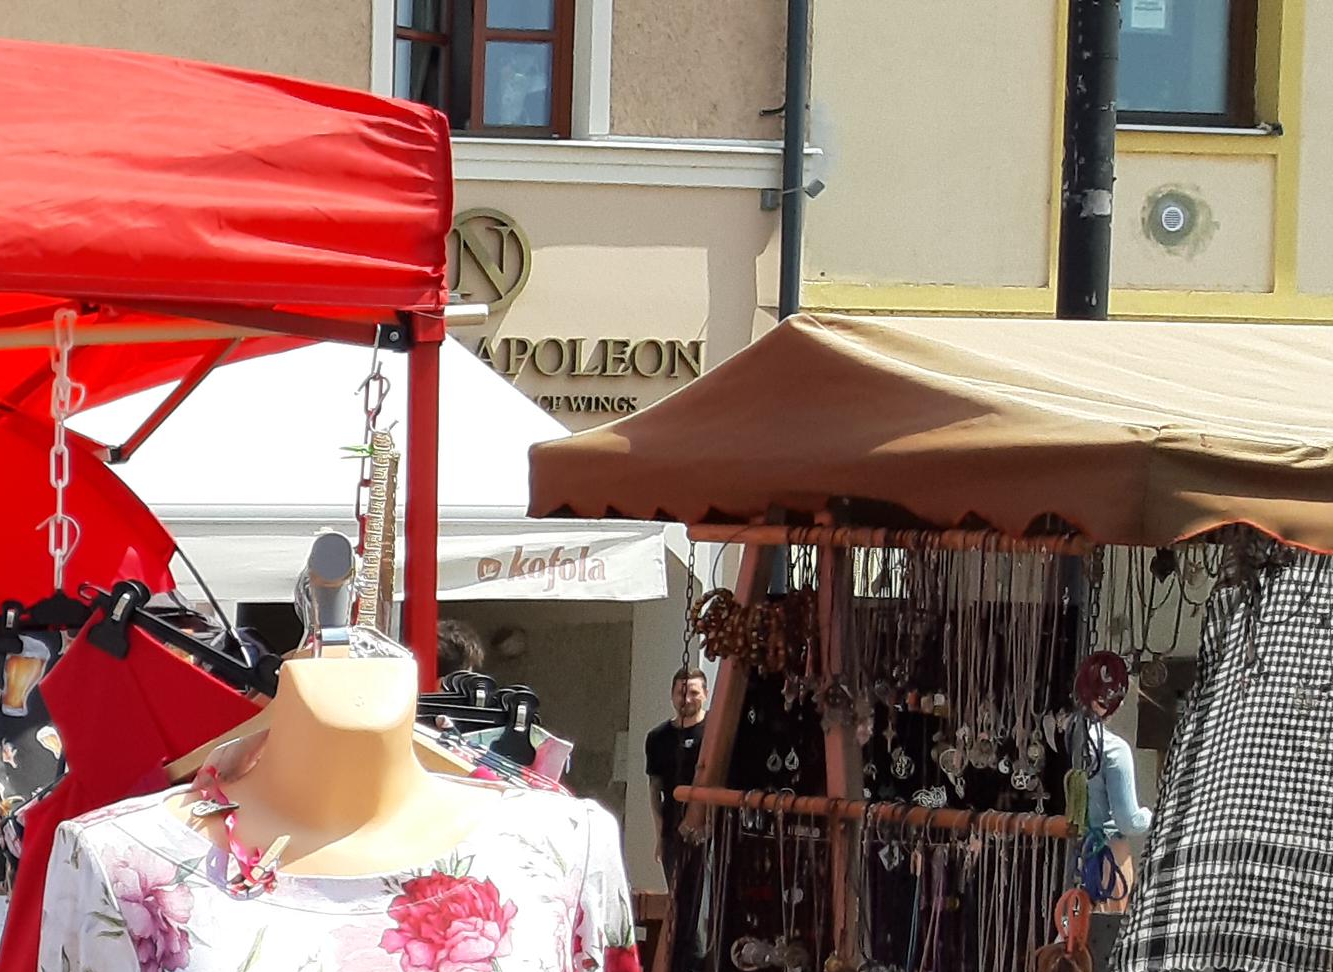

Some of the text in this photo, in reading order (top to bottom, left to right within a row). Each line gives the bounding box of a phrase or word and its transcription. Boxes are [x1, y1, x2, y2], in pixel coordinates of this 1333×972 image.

[474, 335, 706, 379] APOLEON
[568, 395, 638, 413] WINGS
[507, 545, 606, 592] kofola
